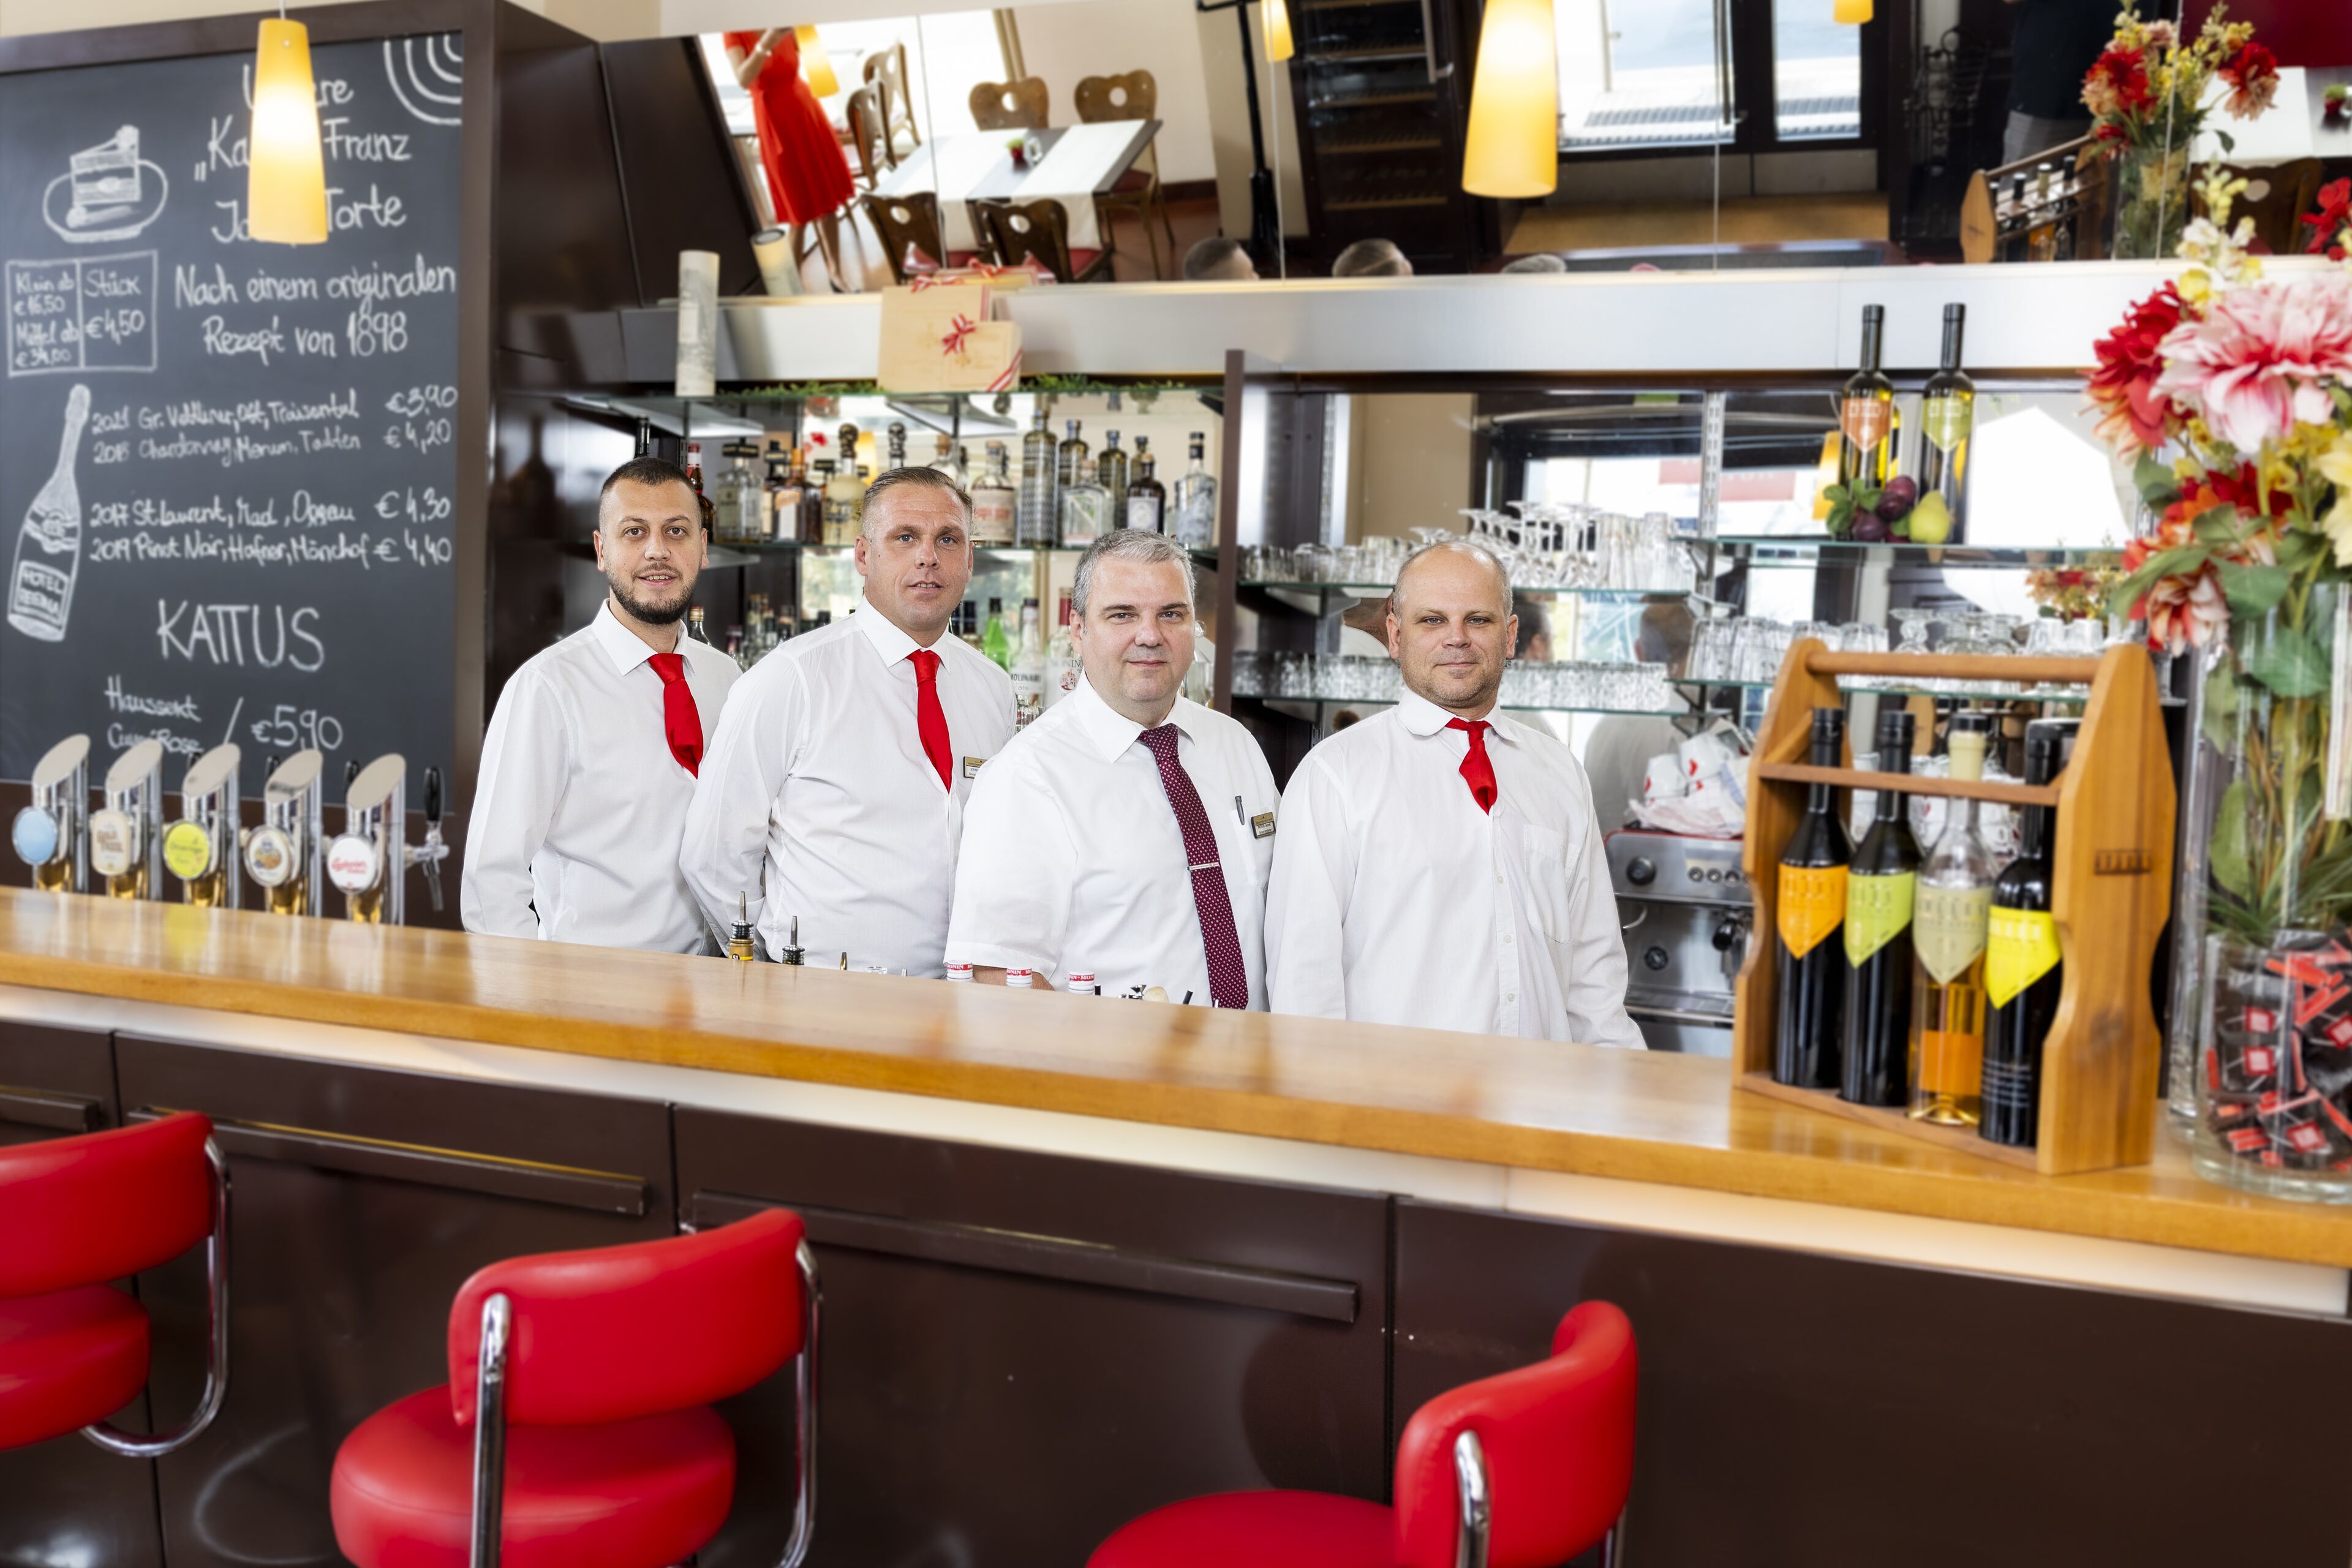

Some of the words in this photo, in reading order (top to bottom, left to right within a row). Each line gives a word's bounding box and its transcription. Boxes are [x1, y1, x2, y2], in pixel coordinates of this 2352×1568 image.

[323, 116, 412, 162] Franz
[325, 183, 407, 233] Torte
[176, 263, 238, 309] Nach
[246, 268, 319, 301] einem
[326, 252, 456, 315] originalen
[85, 308, 146, 346] €4,50
[201, 315, 285, 368] Rezept
[295, 326, 337, 358] von
[346, 311, 409, 357] 1898
[157, 598, 325, 673] KATTUS
